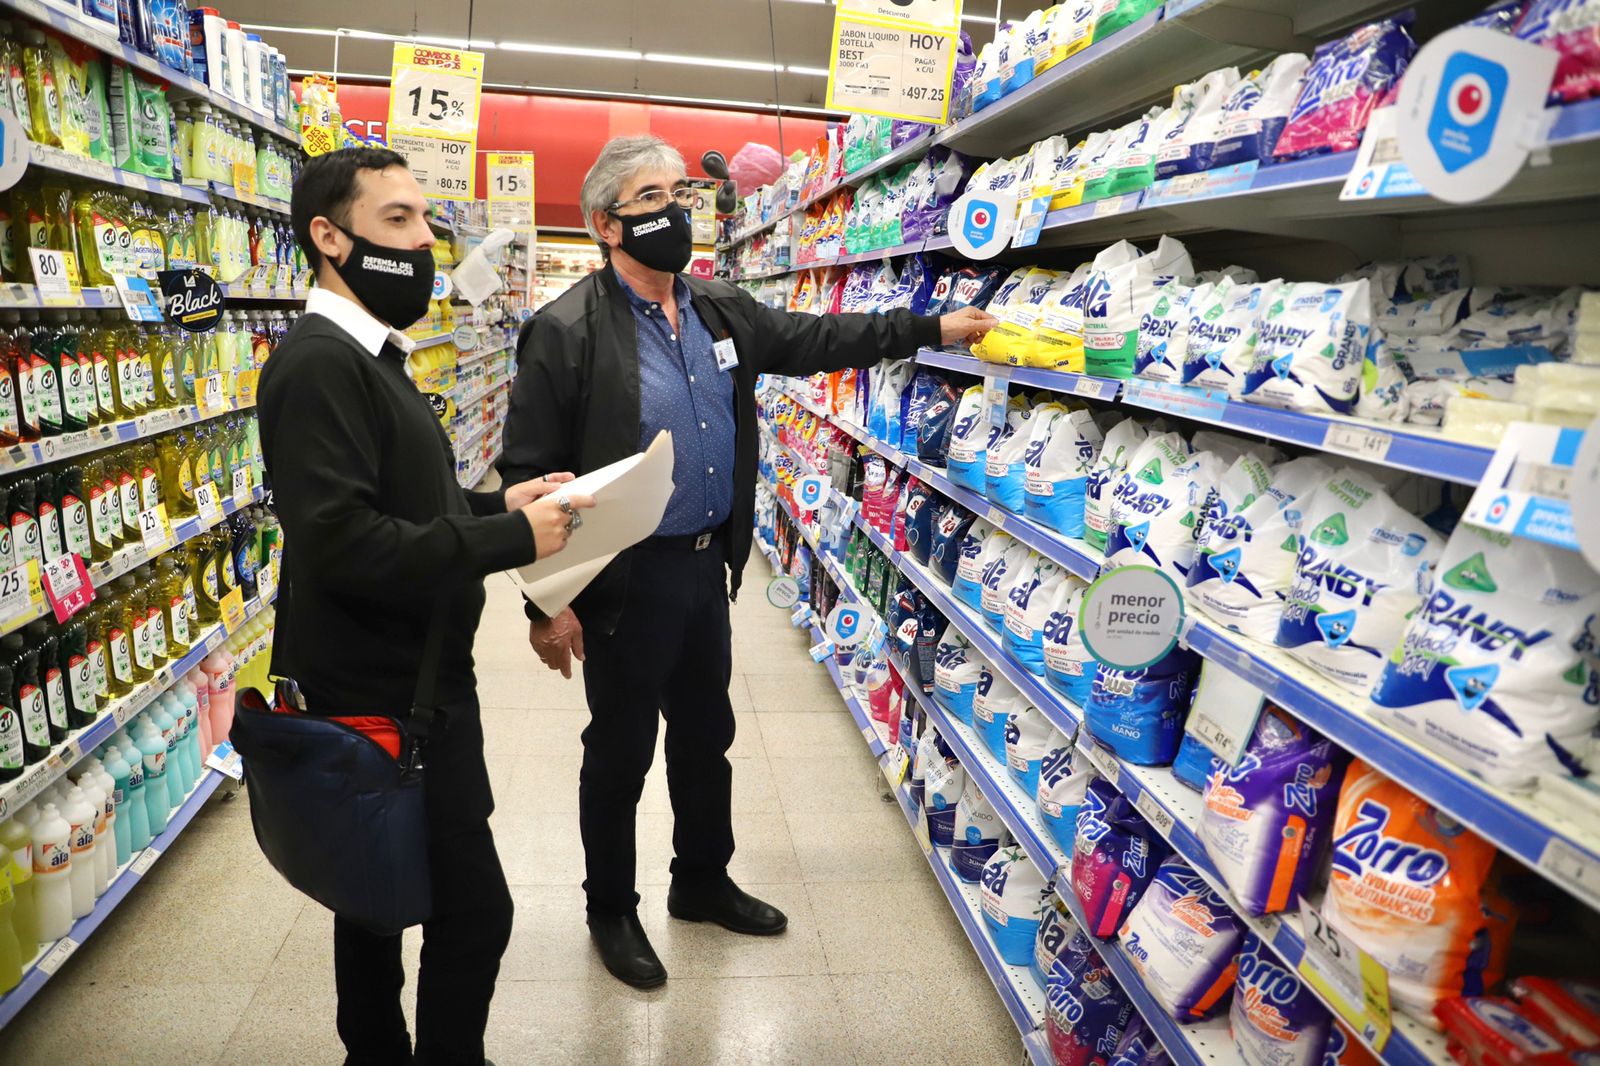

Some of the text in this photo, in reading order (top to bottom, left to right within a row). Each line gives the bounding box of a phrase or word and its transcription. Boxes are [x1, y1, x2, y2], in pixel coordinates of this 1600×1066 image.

[877, 7, 911, 19] Descuento
[839, 39, 875, 49] BOTELLA
[840, 29, 900, 42] JABON LIQUIDO
[909, 34, 945, 51] HOY
[414, 48, 452, 61] COMBOS
[839, 50, 865, 61] BEST
[914, 57, 936, 66] PAGAS
[921, 66, 934, 74] C/U
[144, 137, 158, 147] x5
[305, 126, 321, 143] DES
[308, 132, 329, 153] CUEN
[391, 137, 425, 148] DETERGENTE
[441, 142, 467, 155] HOY
[444, 158, 461, 166] PAGAS
[632, 216, 669, 232] DEFENSA DEL
[633, 222, 671, 237] CONSUMIDOR
[38, 254, 58, 277] 80
[361, 262, 414, 277] CONSUMIDOR
[363, 255, 414, 271] DEFENSA DEL
[169, 283, 222, 318] Black
[208, 377, 217, 394] 70
[198, 488, 209, 506] 80
[142, 511, 156, 531] 25
[1, 570, 20, 598] 25
[260, 568, 269, 586] 80
[1110, 593, 1166, 609] menor
[1107, 608, 1161, 626] precio
[1111, 723, 1141, 740] MANO
[1284, 762, 1318, 818] Zorro
[1332, 799, 1449, 884] Zorro
[1123, 835, 1147, 879] Zorro
[1361, 872, 1436, 904] EVOLUTION
[1353, 883, 1436, 922] QUITAMANCHAS
[1309, 909, 1342, 959] 25
[1124, 931, 1149, 963] Zorro
[1046, 958, 1085, 1024] Zorro
